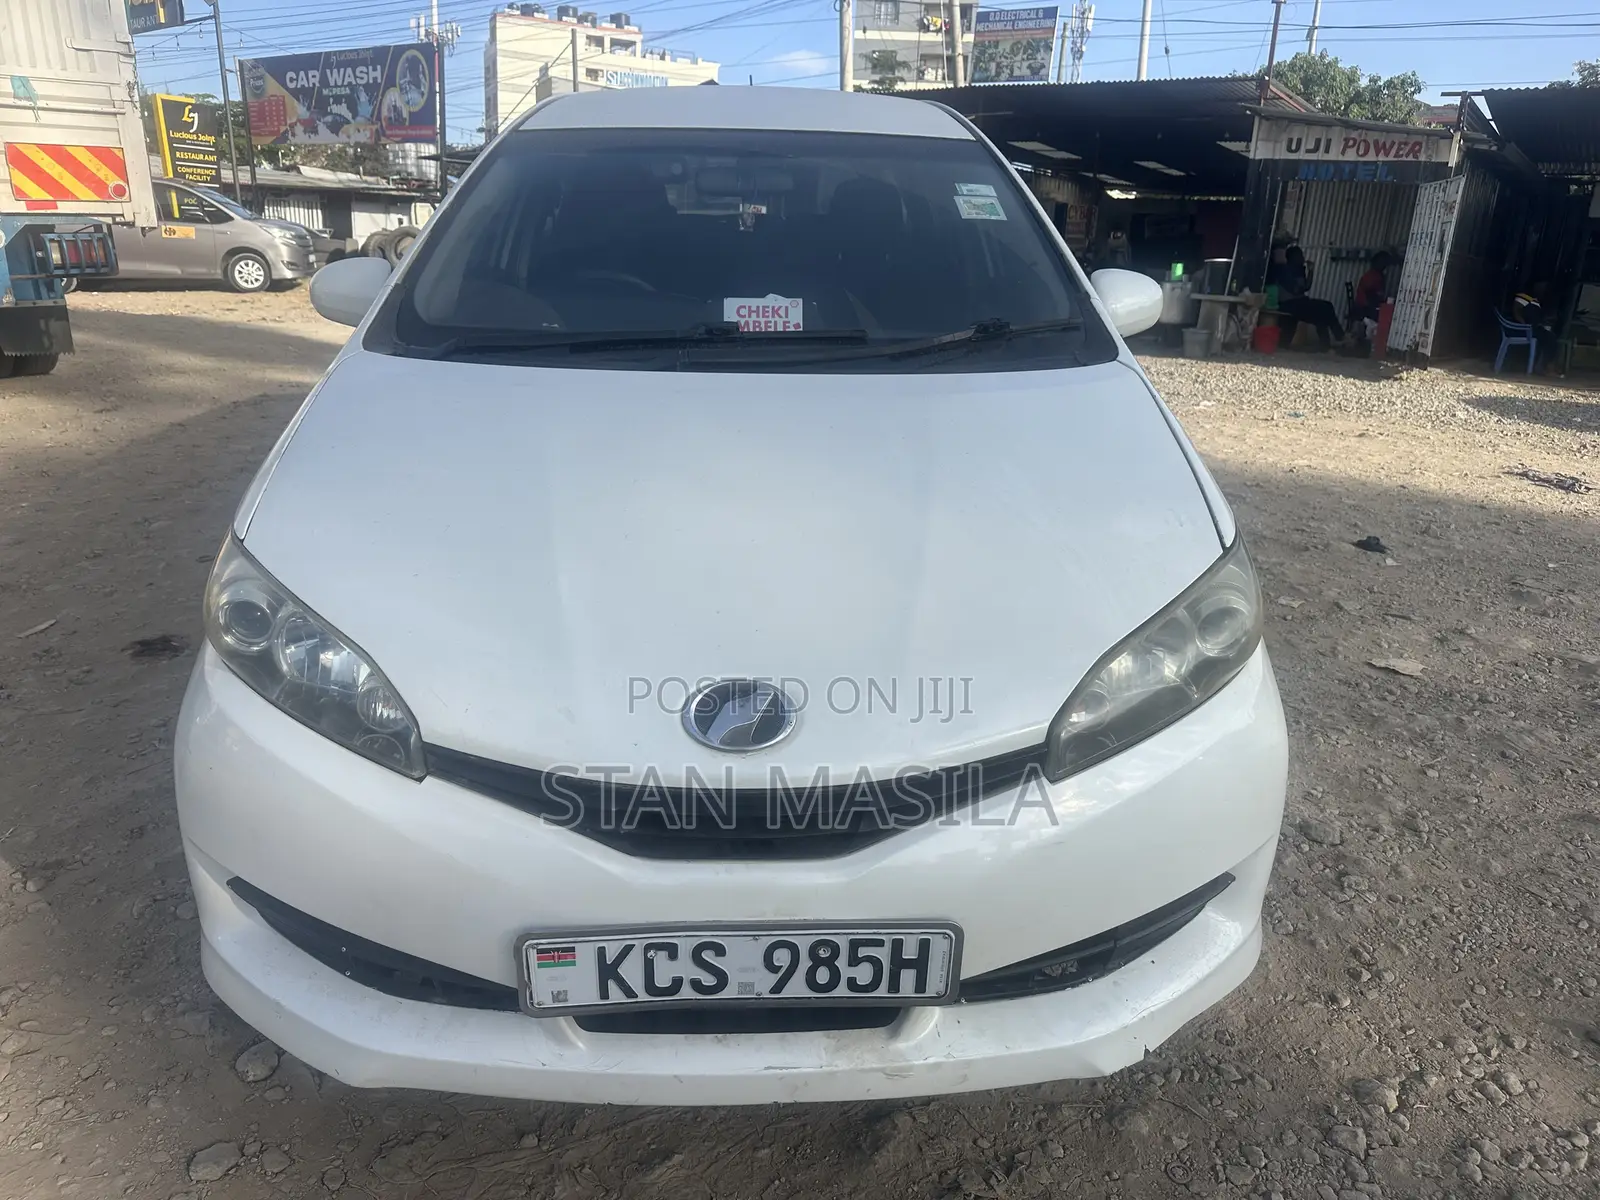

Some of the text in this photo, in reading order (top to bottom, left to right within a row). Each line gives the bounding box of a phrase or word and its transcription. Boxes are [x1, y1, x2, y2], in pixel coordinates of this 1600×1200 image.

[1001, 9, 1037, 20] ELECTRICAL
[976, 19, 1056, 31] MECHANICAL ENGINEERING
[285, 65, 382, 89] CAR WASH
[170, 130, 197, 141] Lucious
[197, 133, 216, 145] Joint
[1285, 136, 1423, 160] UJI POWER
[175, 151, 217, 162] RESTAURANT
[177, 166, 216, 176] CONFERENCE
[185, 173, 211, 182] FACILITY
[1298, 162, 1394, 181] HOTEL
[735, 305, 789, 319] CHEKI
[596, 938, 729, 1000] KCS
[762, 936, 932, 995] 985H
